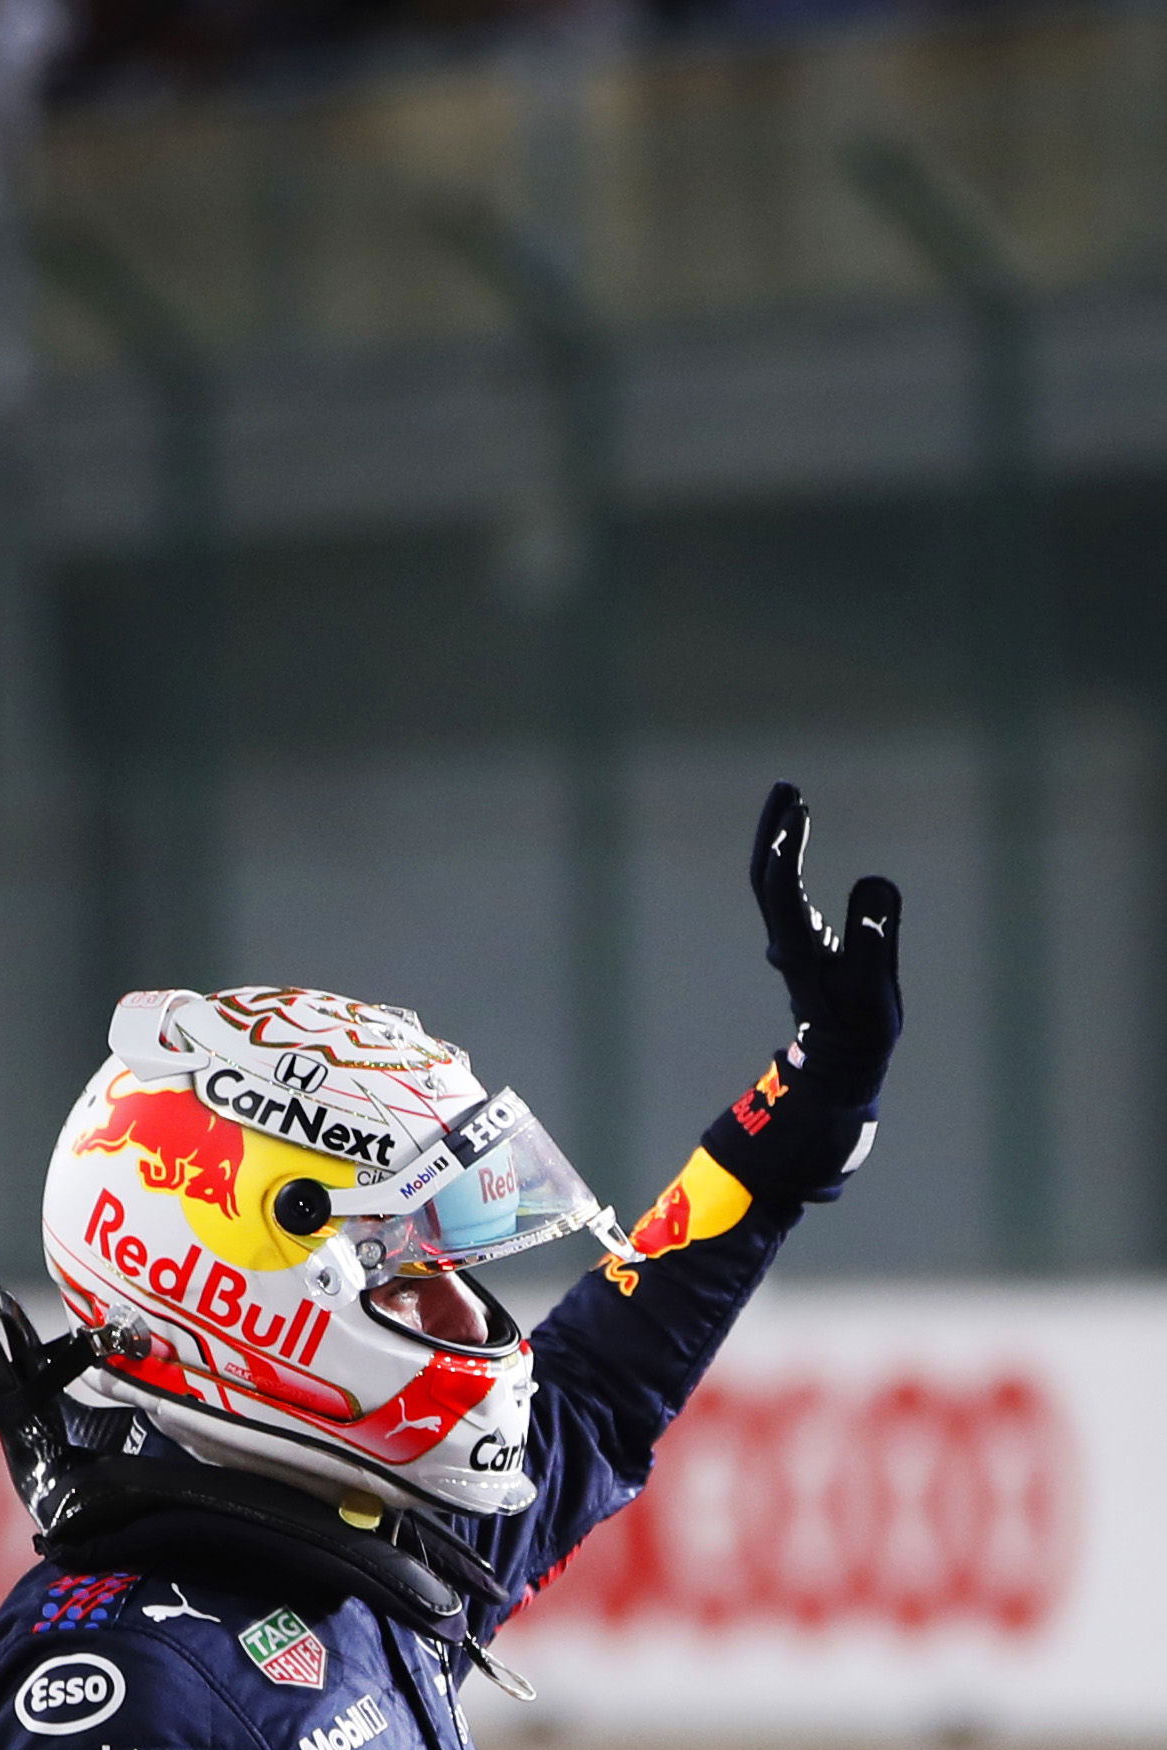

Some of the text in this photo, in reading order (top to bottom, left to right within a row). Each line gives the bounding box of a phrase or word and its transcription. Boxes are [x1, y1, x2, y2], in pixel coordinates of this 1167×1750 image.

[206, 1069, 396, 1166] CarNext
[246, 1614, 304, 1657] TAG
[266, 1638, 322, 1683] HEUER
